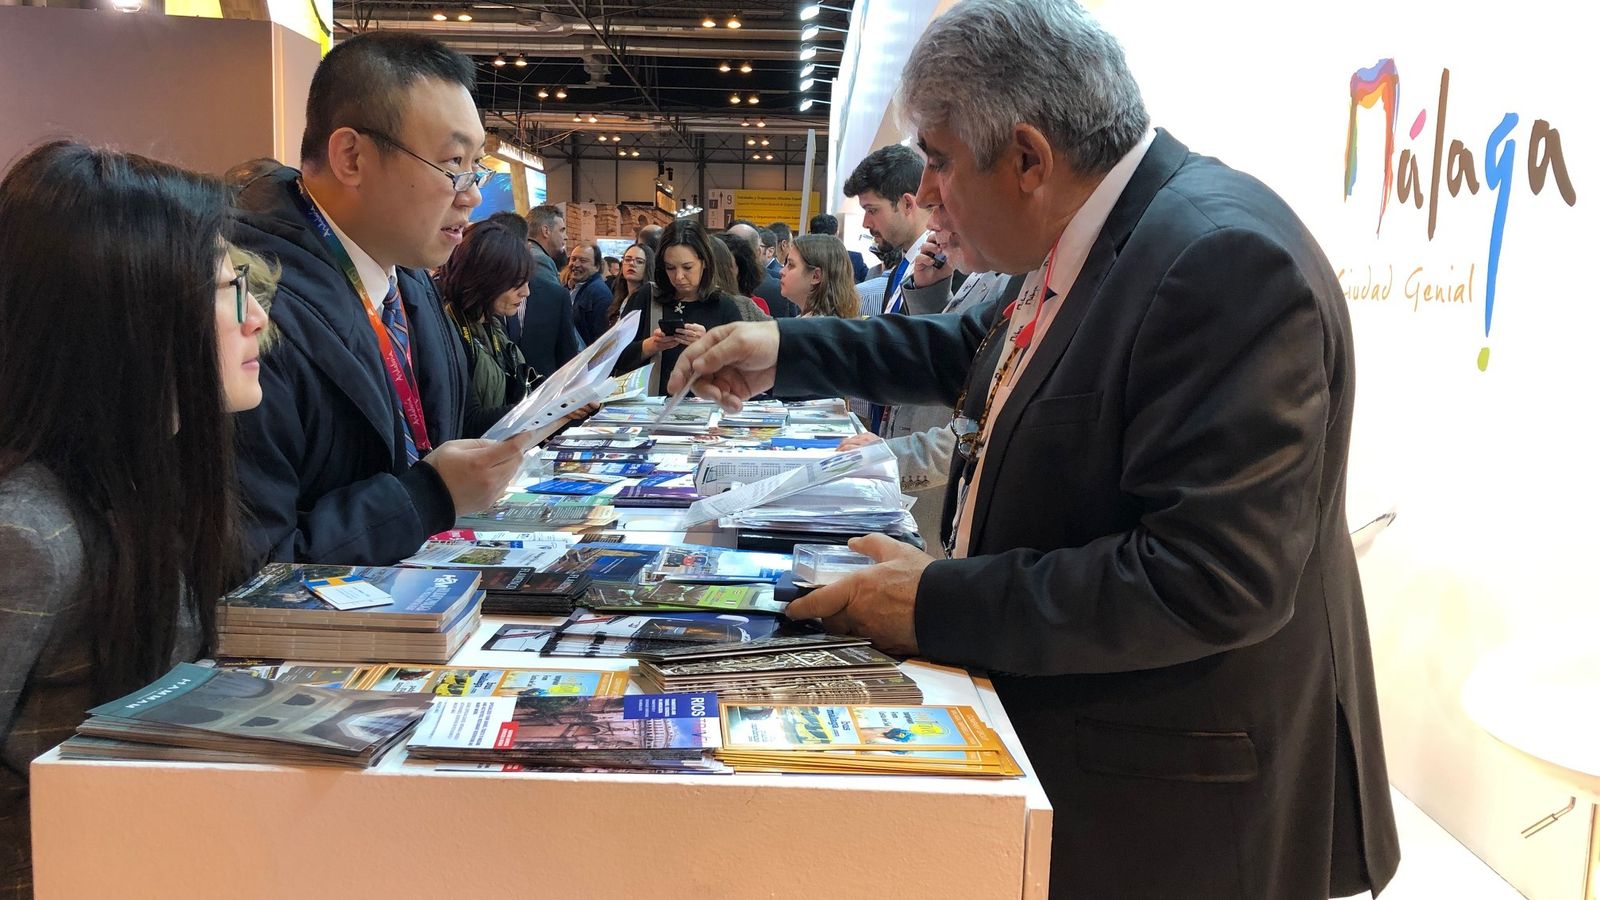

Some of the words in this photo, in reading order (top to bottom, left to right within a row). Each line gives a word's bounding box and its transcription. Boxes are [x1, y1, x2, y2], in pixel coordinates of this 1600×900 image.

[726, 194, 733, 205] 9
[1343, 57, 1577, 338] Málaga
[1404, 262, 1476, 312] Genial
[124, 678, 192, 710] HAMMAM
[690, 697, 706, 717] RIOS
